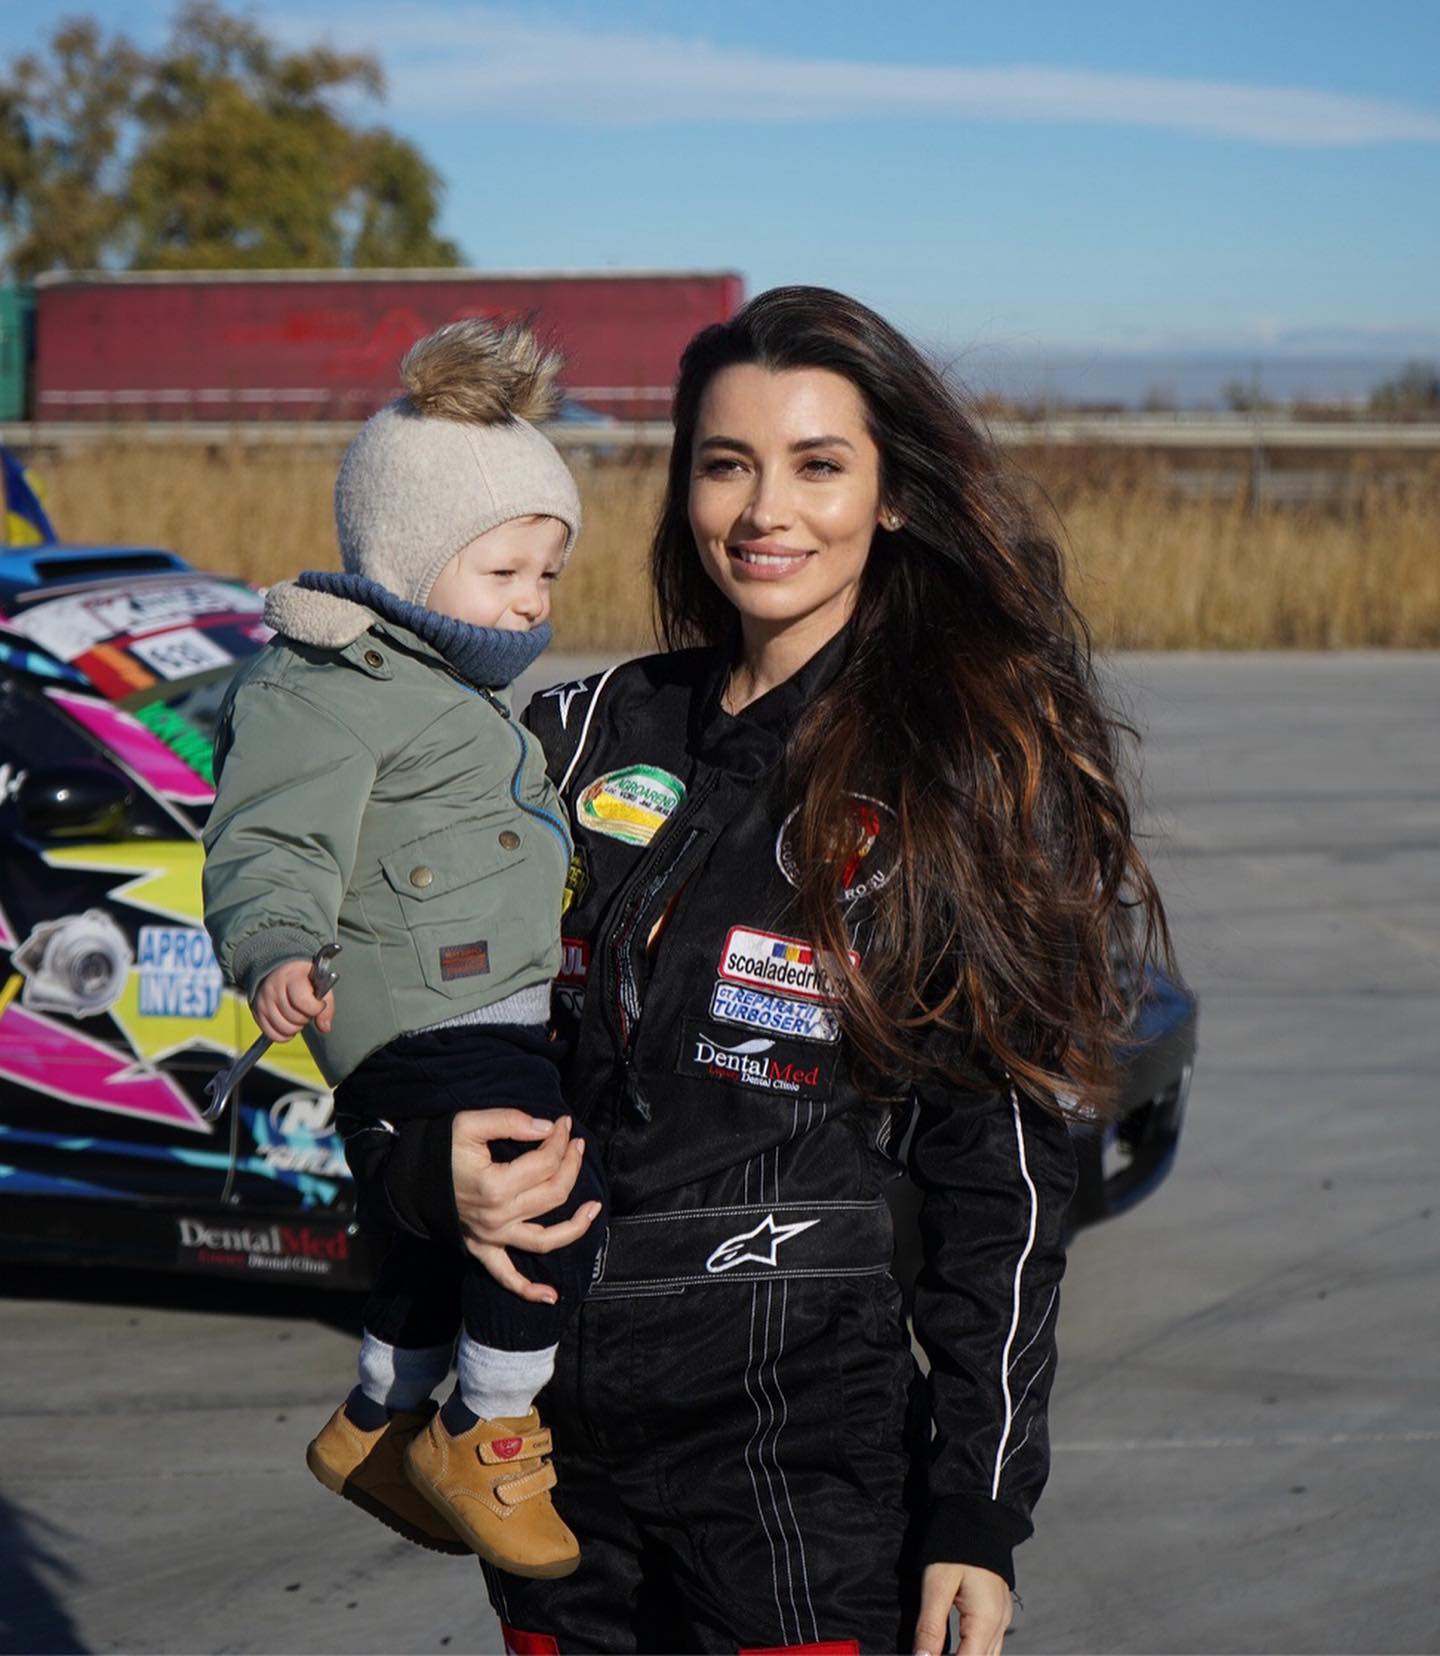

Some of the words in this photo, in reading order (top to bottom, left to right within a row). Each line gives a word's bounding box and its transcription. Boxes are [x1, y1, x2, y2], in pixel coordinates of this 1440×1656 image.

[141, 972, 220, 1016] INVEST
[715, 1000, 816, 1034] TURBOSERV
[695, 1042, 819, 1086] DentalMed
[741, 1072, 772, 1088] Dental
[179, 1219, 348, 1260] DentalMed
